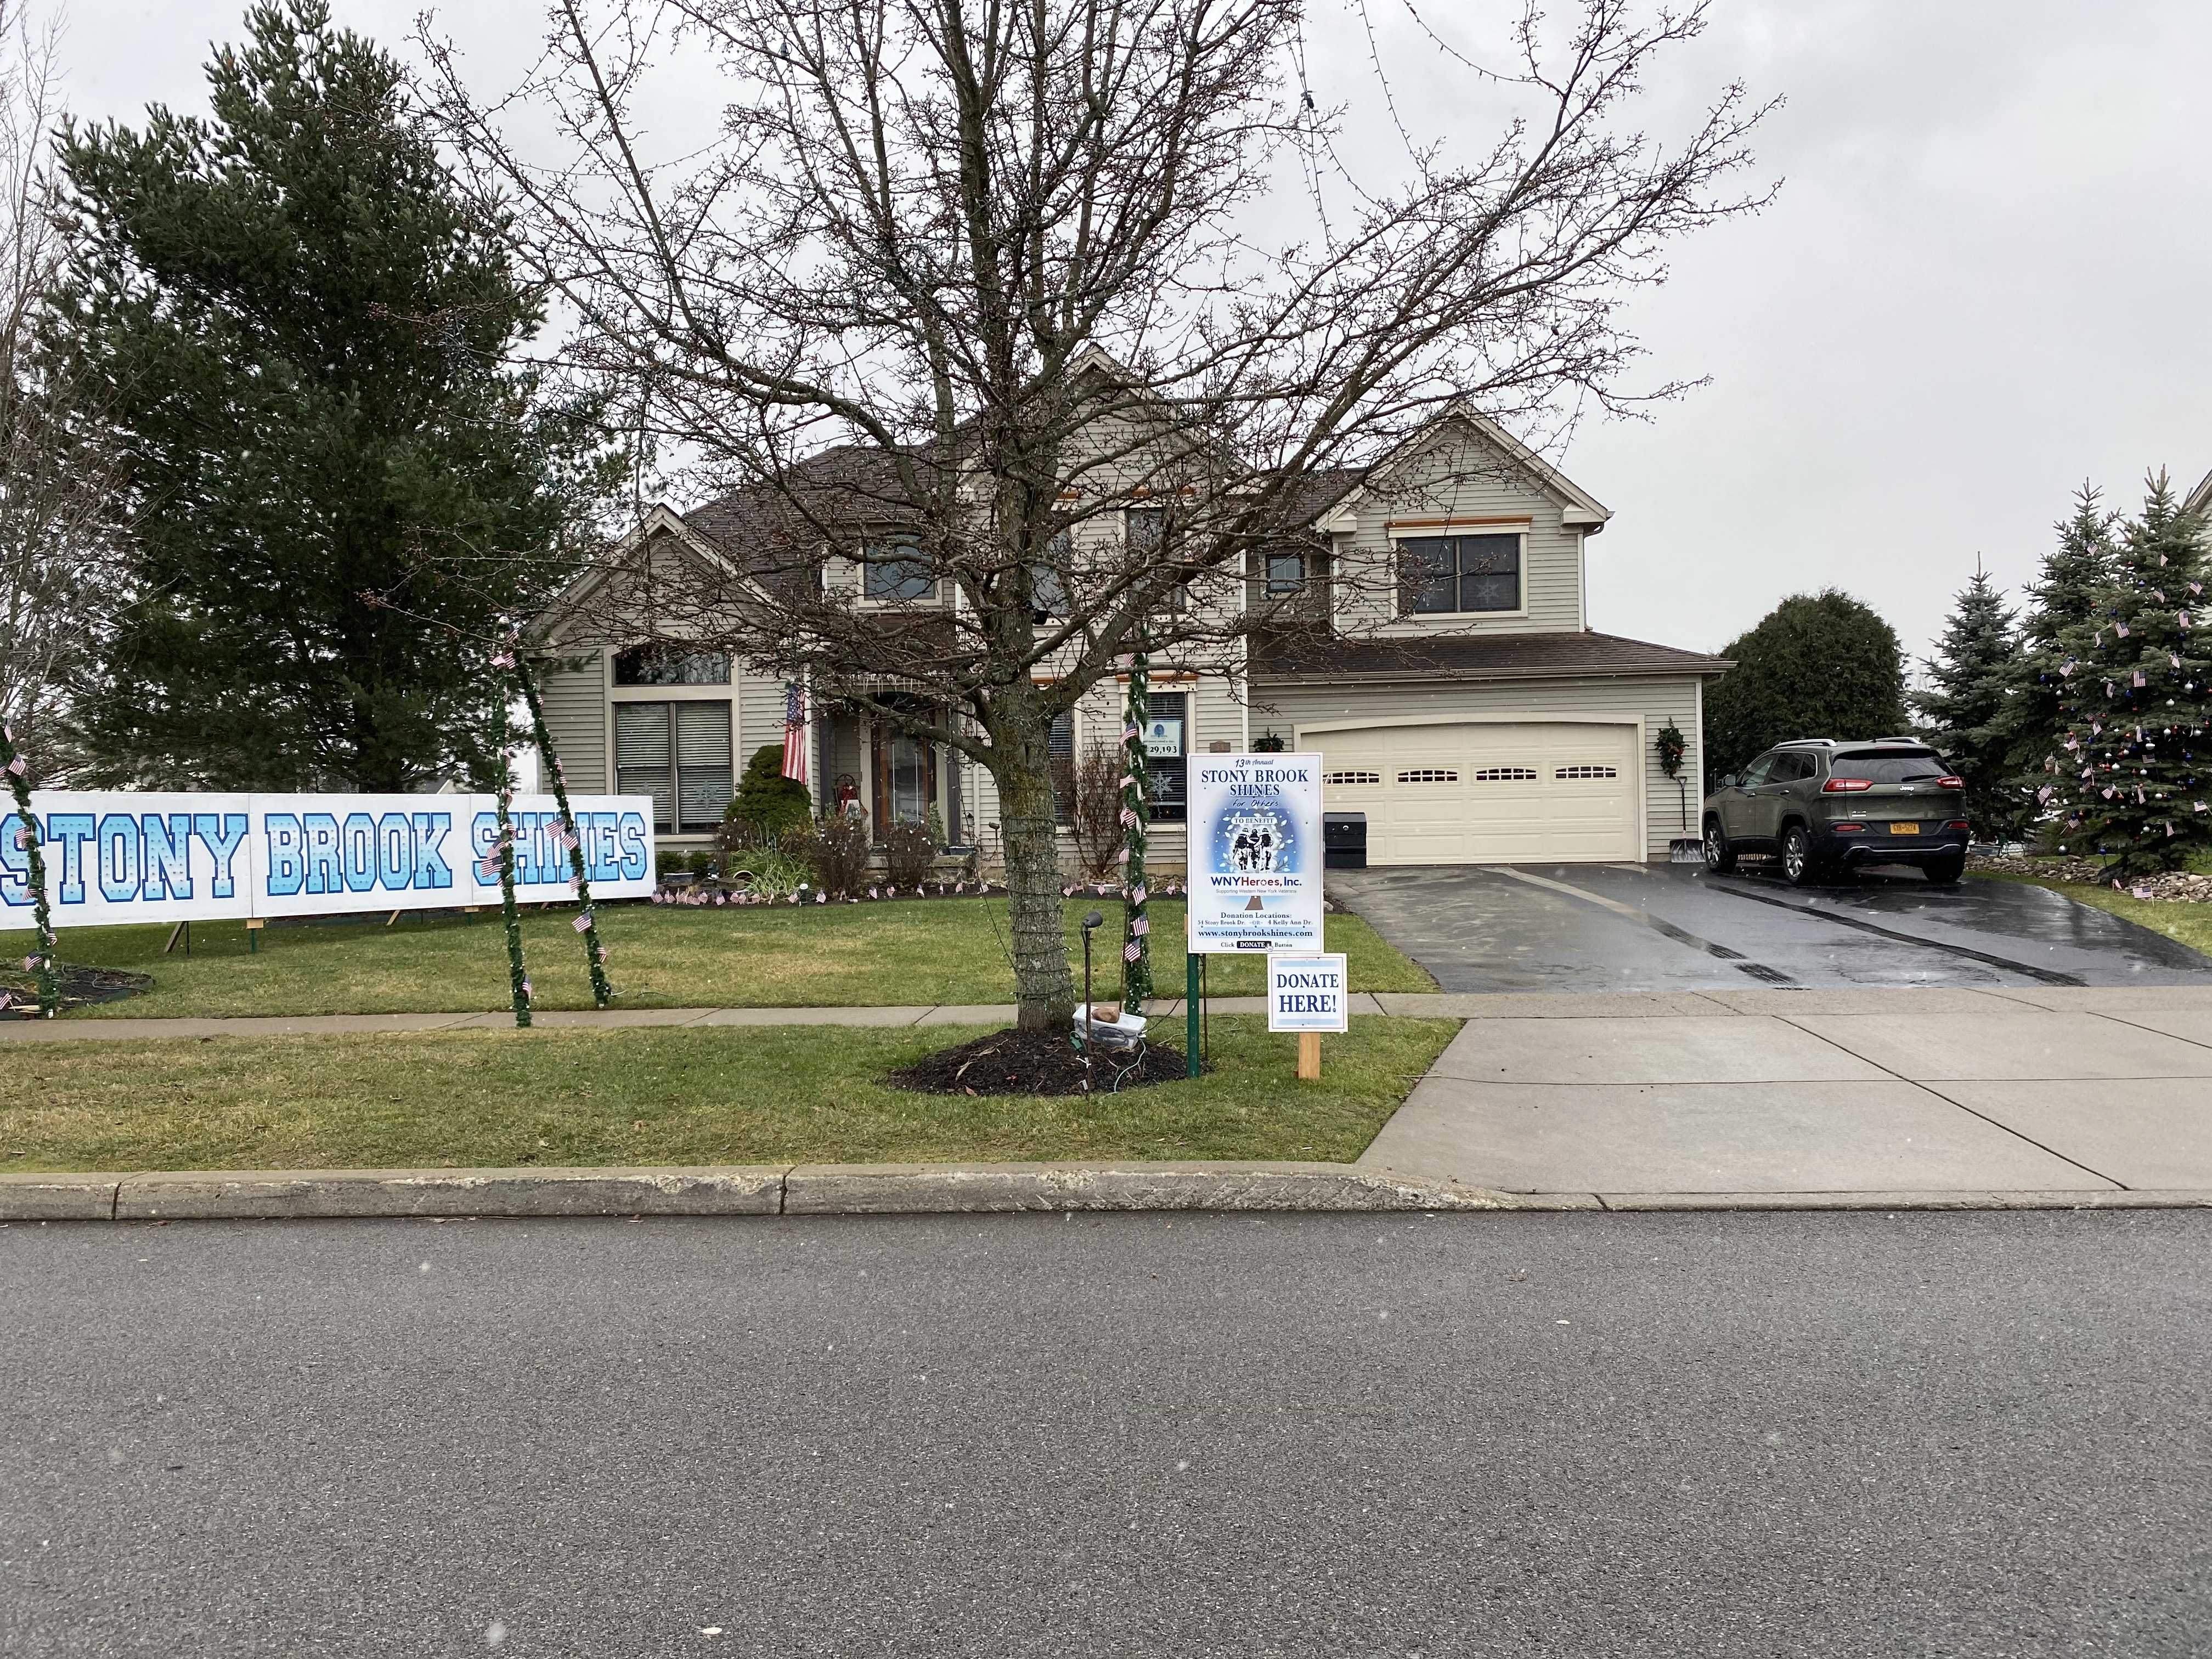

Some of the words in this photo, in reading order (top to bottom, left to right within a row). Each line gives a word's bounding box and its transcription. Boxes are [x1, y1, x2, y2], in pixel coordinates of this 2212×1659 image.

[1235, 759, 1251, 768] 13th
[1201, 770, 1249, 783] STONY
[1255, 769, 1309, 782] BROOK
[1230, 784, 1280, 796] SHINES
[1232, 799, 1246, 808] for
[1250, 799, 1279, 807] Others
[0, 812, 249, 907] STONY
[264, 812, 453, 896] BROOK
[1211, 876, 1283, 887] WNYHeroes,
[1284, 876, 1302, 886] Inc.
[1198, 929, 1313, 938] www.stonybrookshines.com
[1277, 974, 1339, 988] DONATE
[1279, 995, 1336, 1013] HERE!
